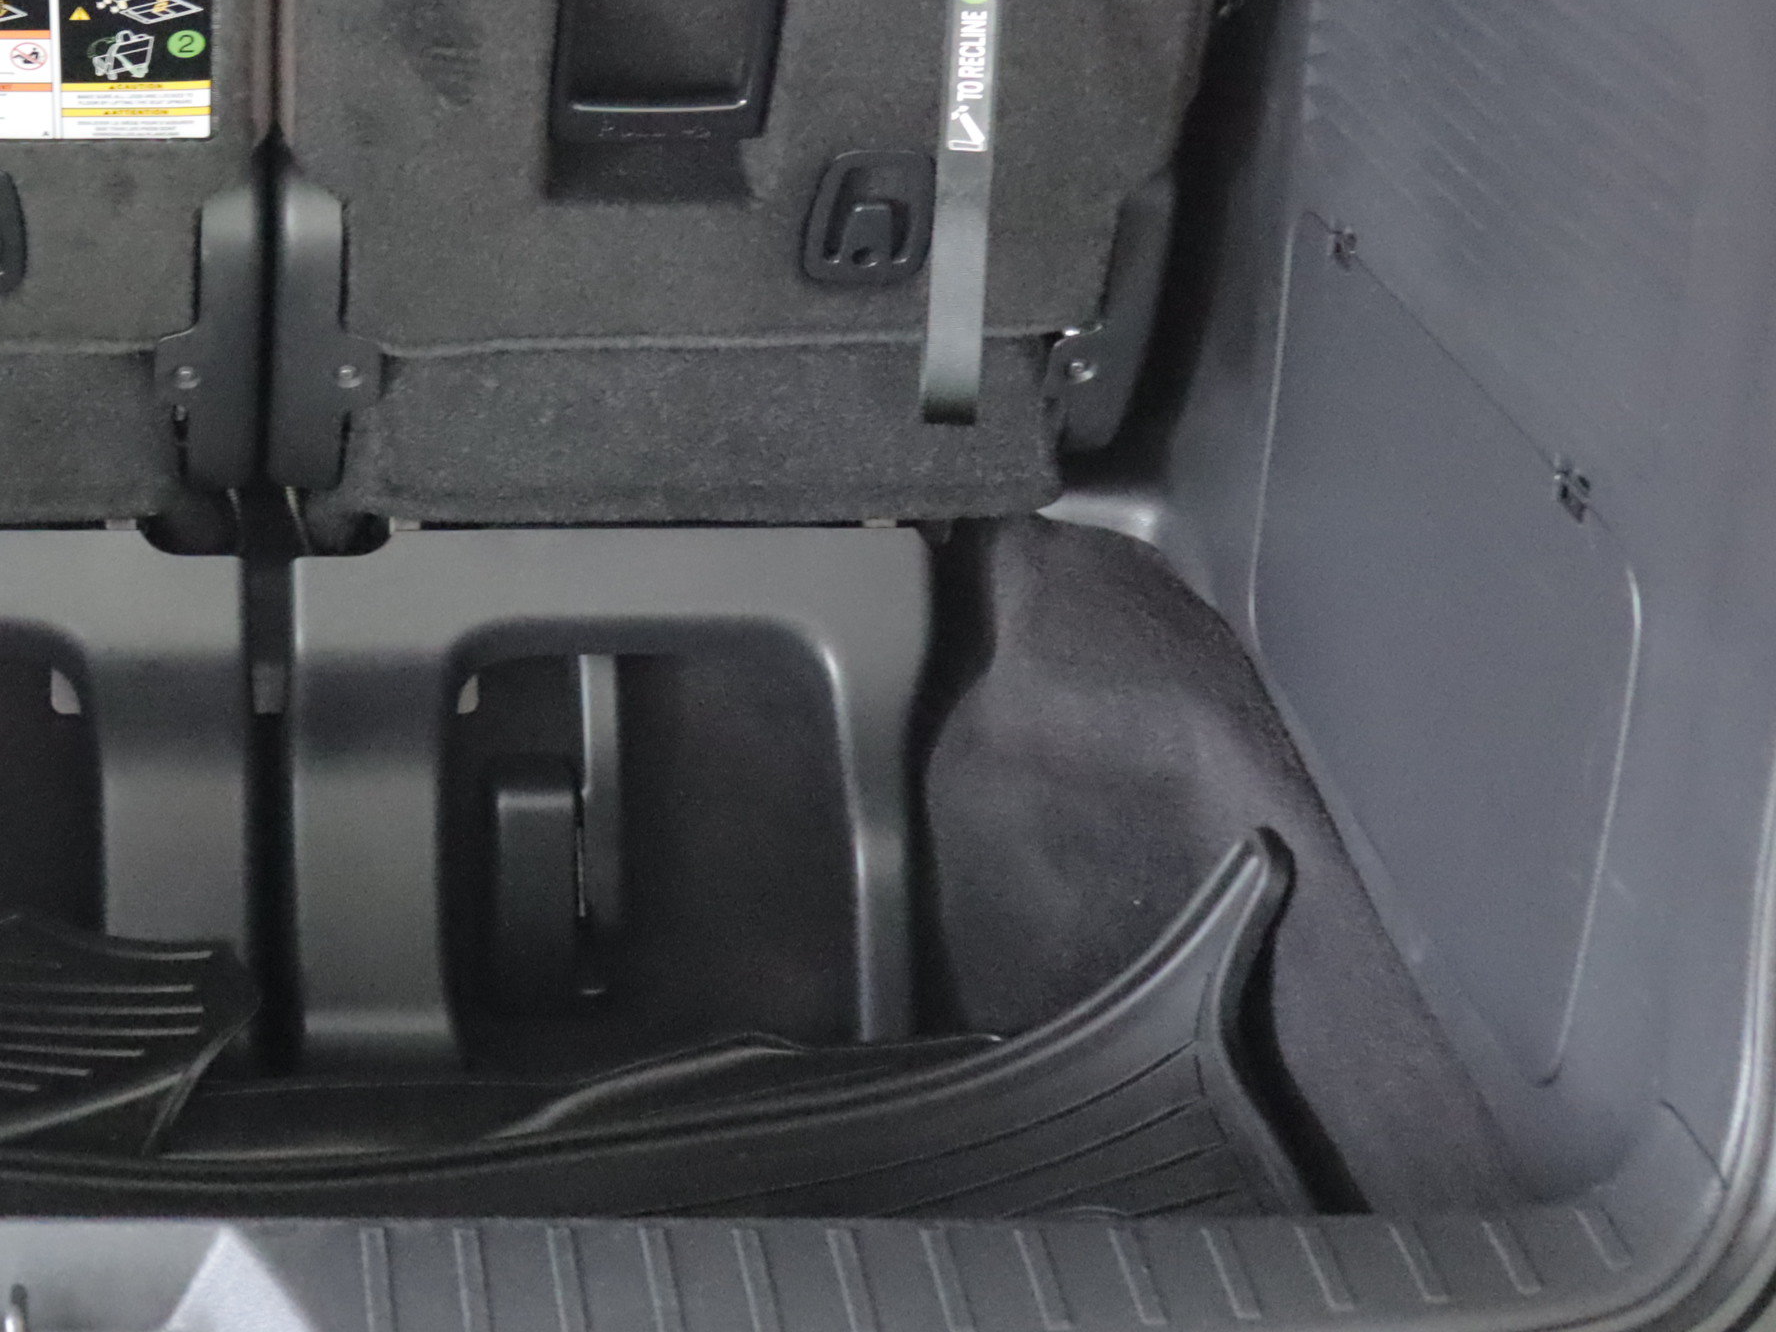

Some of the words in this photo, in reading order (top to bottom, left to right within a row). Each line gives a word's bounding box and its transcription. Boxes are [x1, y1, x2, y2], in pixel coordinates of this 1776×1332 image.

[178, 34, 195, 53] 2
[957, 10, 988, 79] RECLINE
[956, 80, 984, 102] TO
